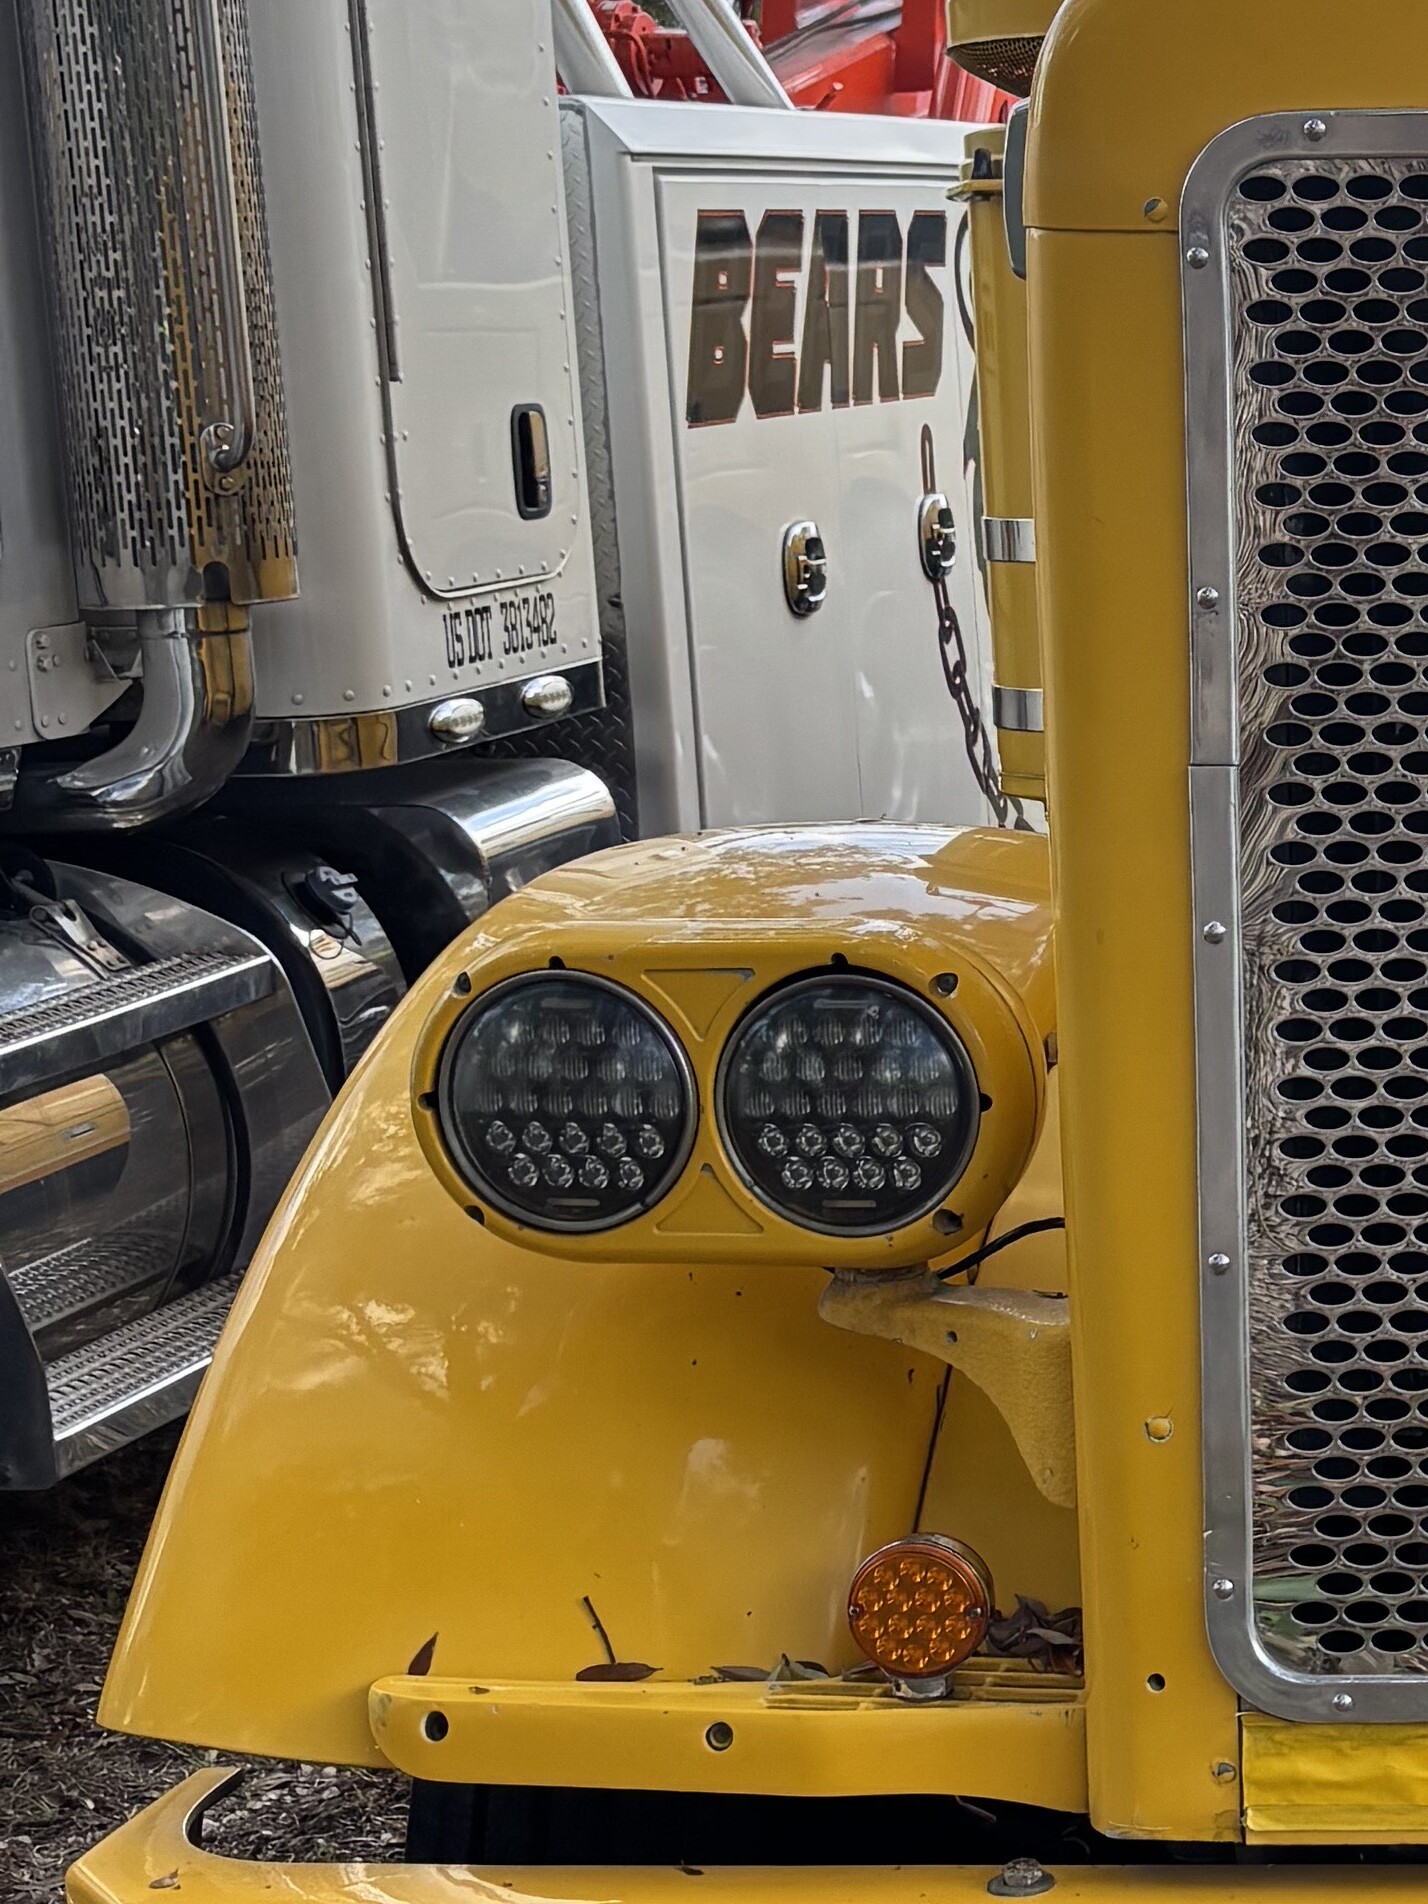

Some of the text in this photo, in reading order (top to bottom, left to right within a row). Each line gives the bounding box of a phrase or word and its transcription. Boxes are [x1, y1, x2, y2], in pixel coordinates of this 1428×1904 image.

[687, 208, 947, 429] BEARS
[443, 592, 557, 668] US DOT 3813482
